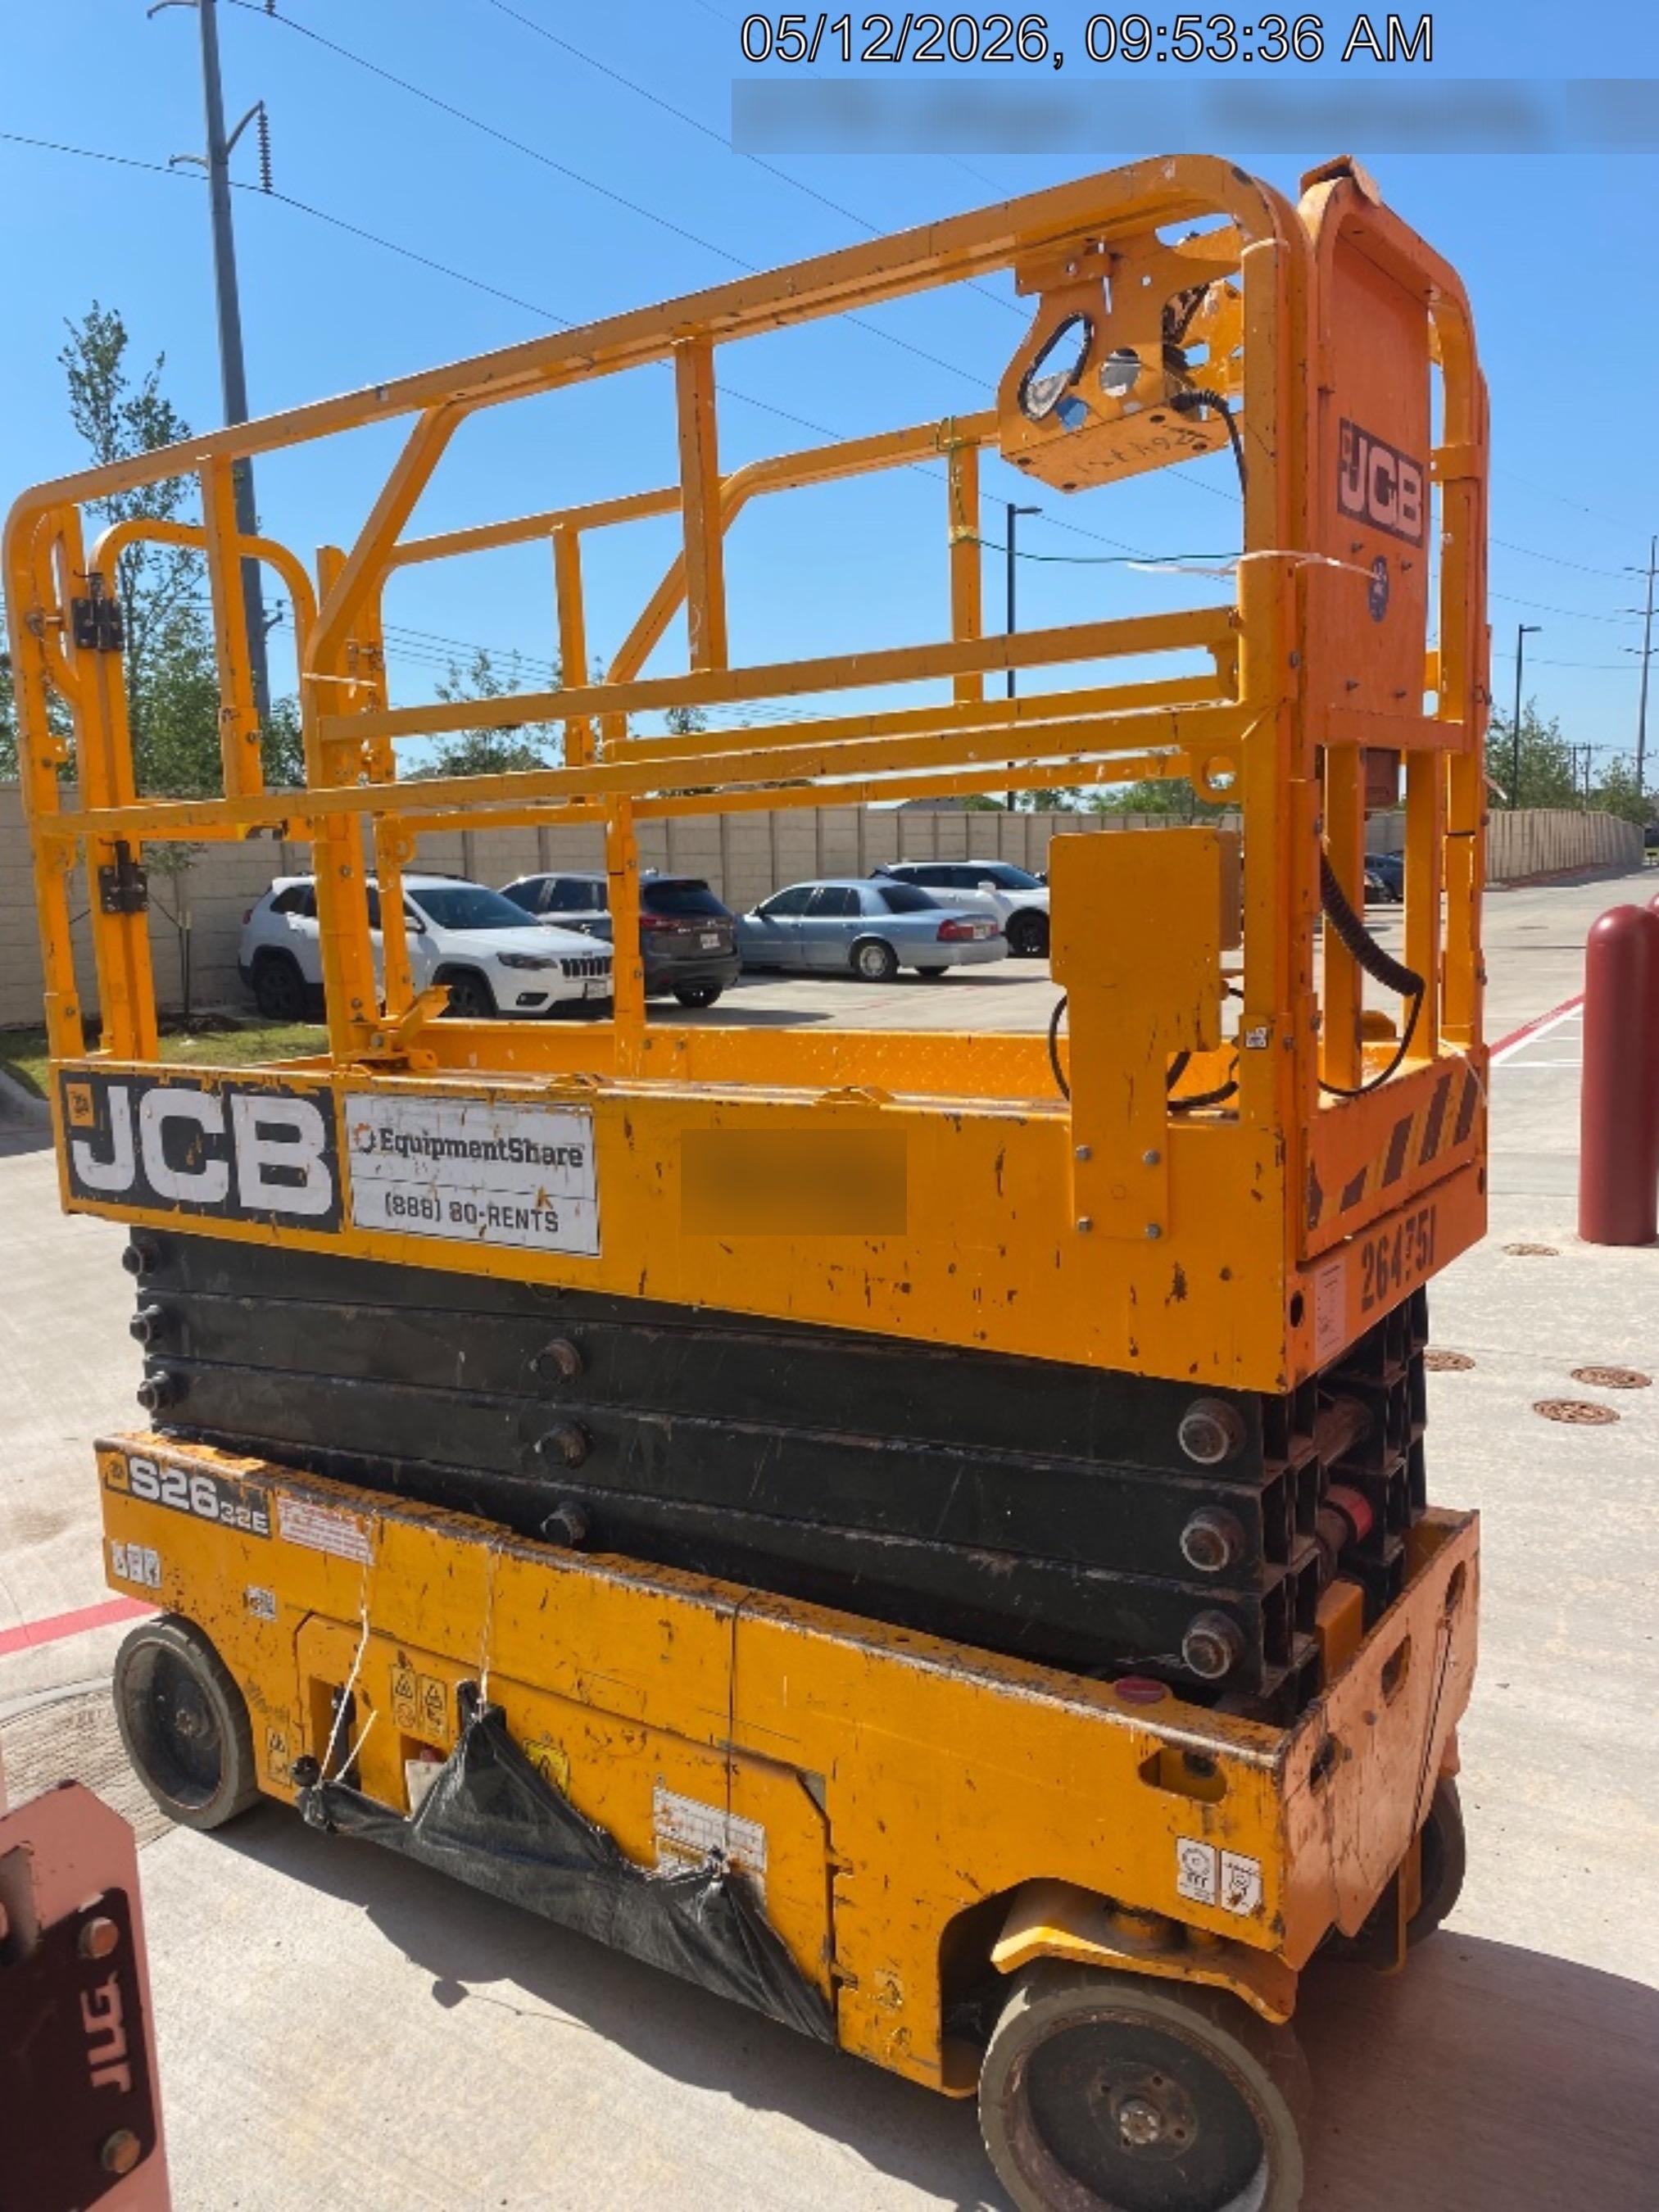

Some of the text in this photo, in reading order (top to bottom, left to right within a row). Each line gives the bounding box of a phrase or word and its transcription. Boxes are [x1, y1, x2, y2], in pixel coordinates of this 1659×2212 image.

[1339, 436, 1422, 537] JCB
[72, 1085, 333, 1216] JCB
[378, 1127, 584, 1167] EquipmentShare
[385, 1191, 559, 1232] (888) 80-RENTS
[1362, 1203, 1436, 1312] 264751
